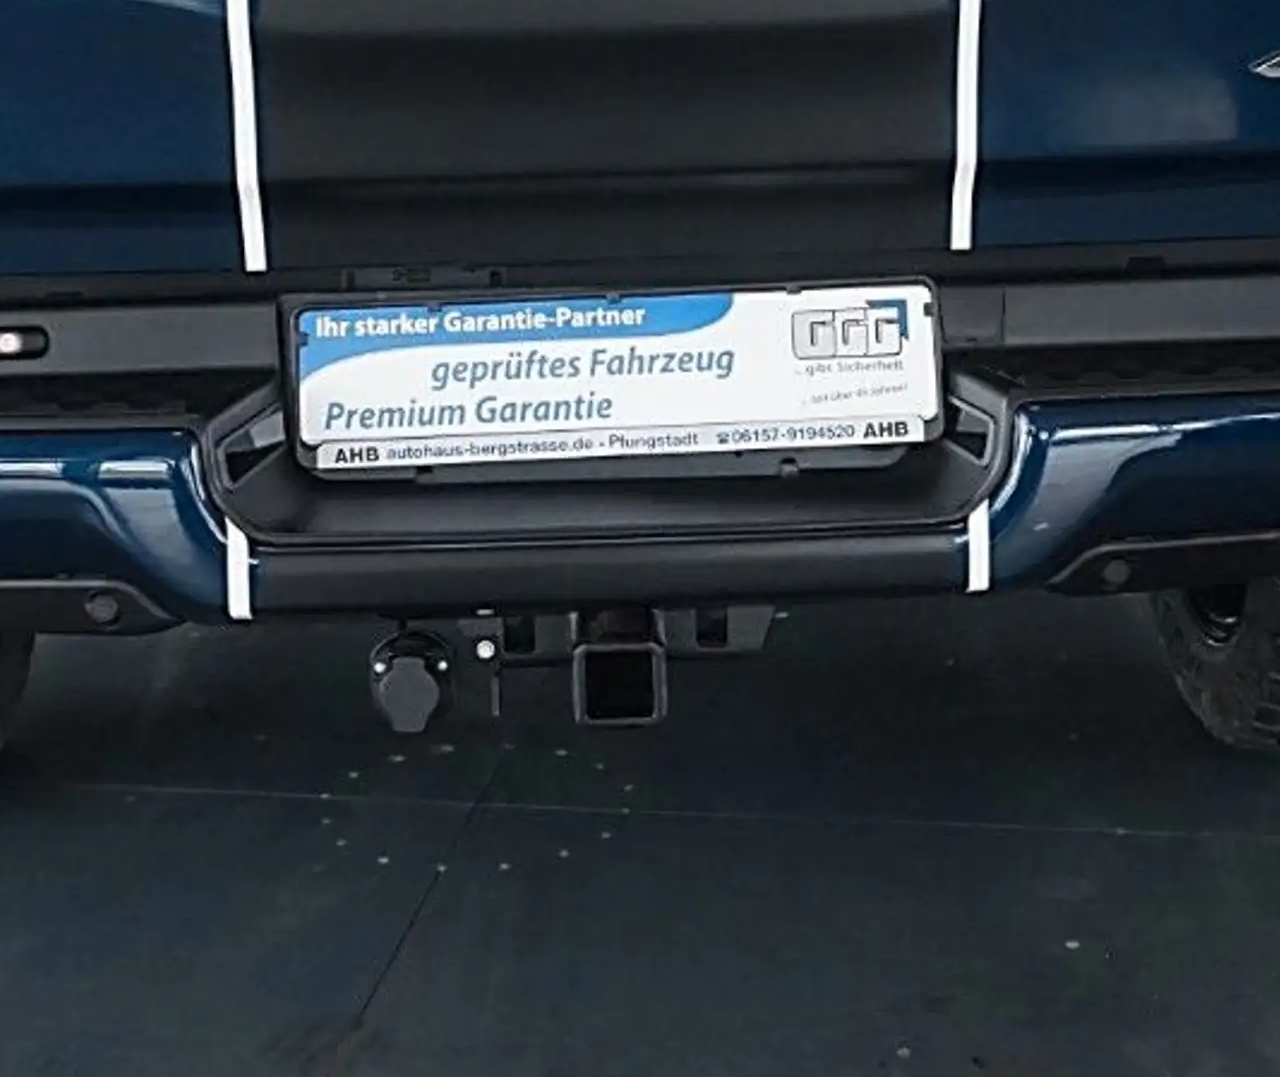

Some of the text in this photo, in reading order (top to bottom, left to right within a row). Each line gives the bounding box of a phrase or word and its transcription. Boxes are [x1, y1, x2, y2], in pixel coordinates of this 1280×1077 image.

[315, 306, 646, 338] Ihr starker Garantie-Partner
[431, 345, 736, 391] geprüftes Fahrzeug
[324, 391, 613, 431] Premium Garantie
[334, 446, 381, 464] AHB
[608, 431, 699, 451] Pfungstadt
[863, 420, 910, 439] AHB
